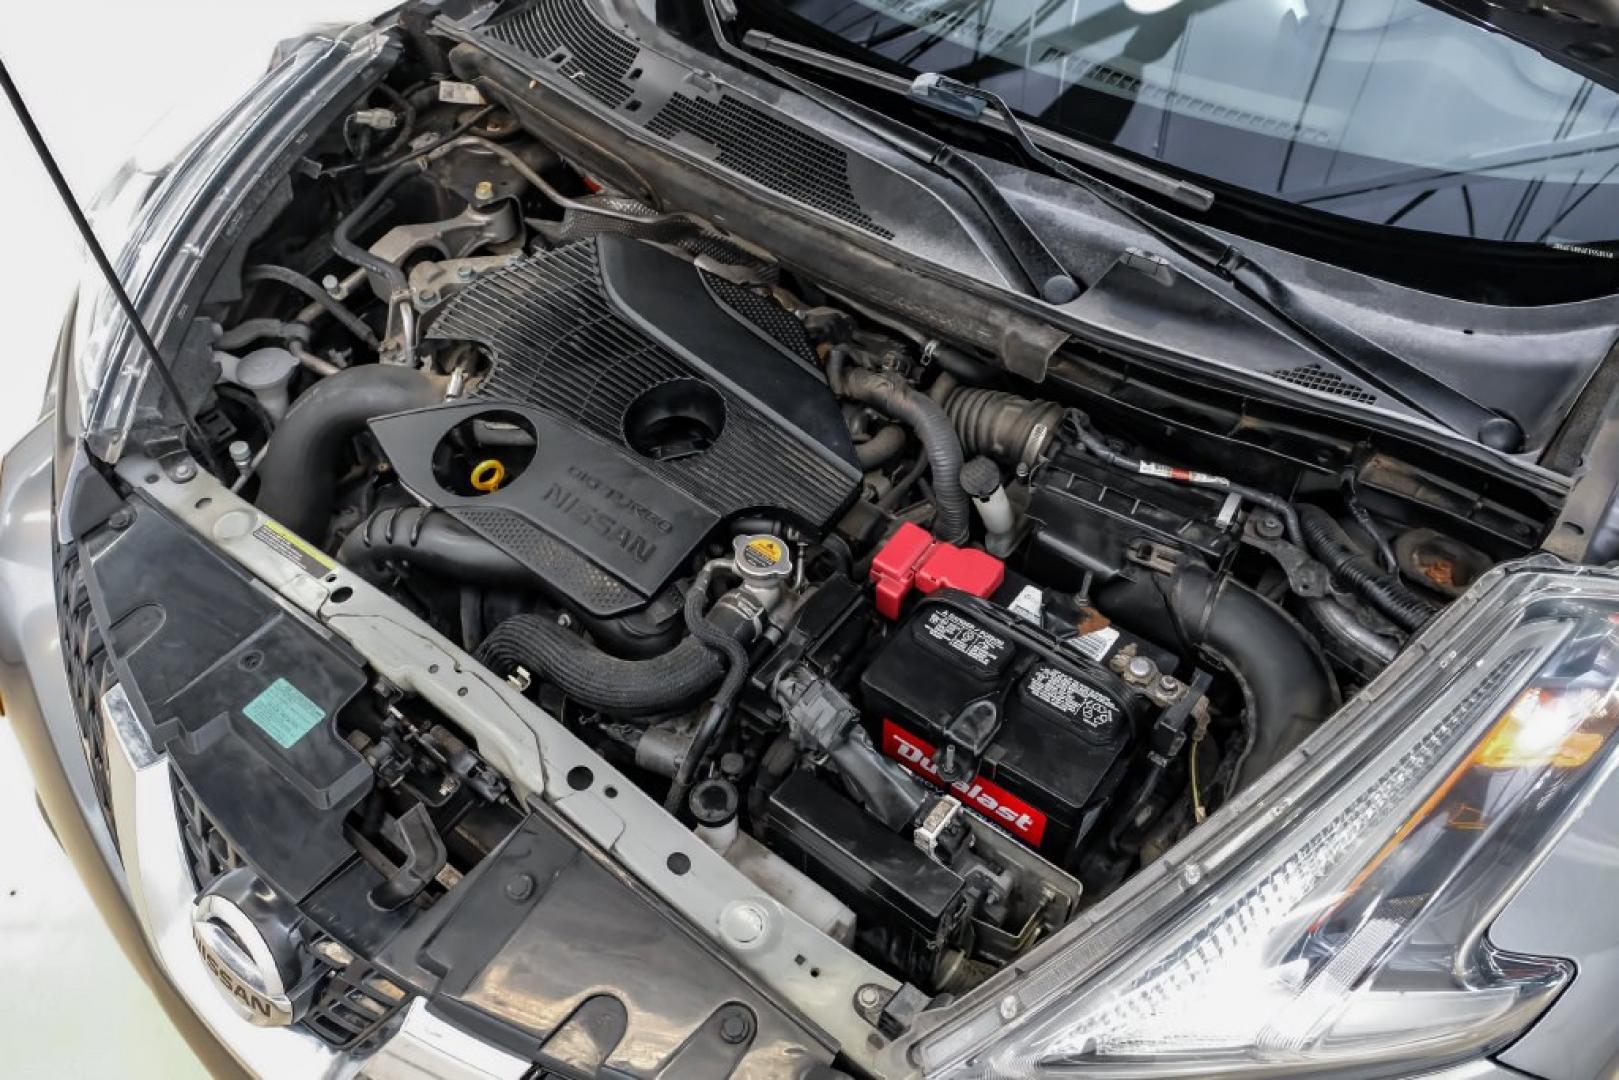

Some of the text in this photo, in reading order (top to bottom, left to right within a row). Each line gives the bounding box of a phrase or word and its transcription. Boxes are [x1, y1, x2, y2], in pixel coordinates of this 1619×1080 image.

[542, 482, 658, 563] NISSAN
[605, 487, 674, 535] TURBO
[892, 734, 1034, 832] Dualast
[192, 924, 272, 1019] NISSAN
